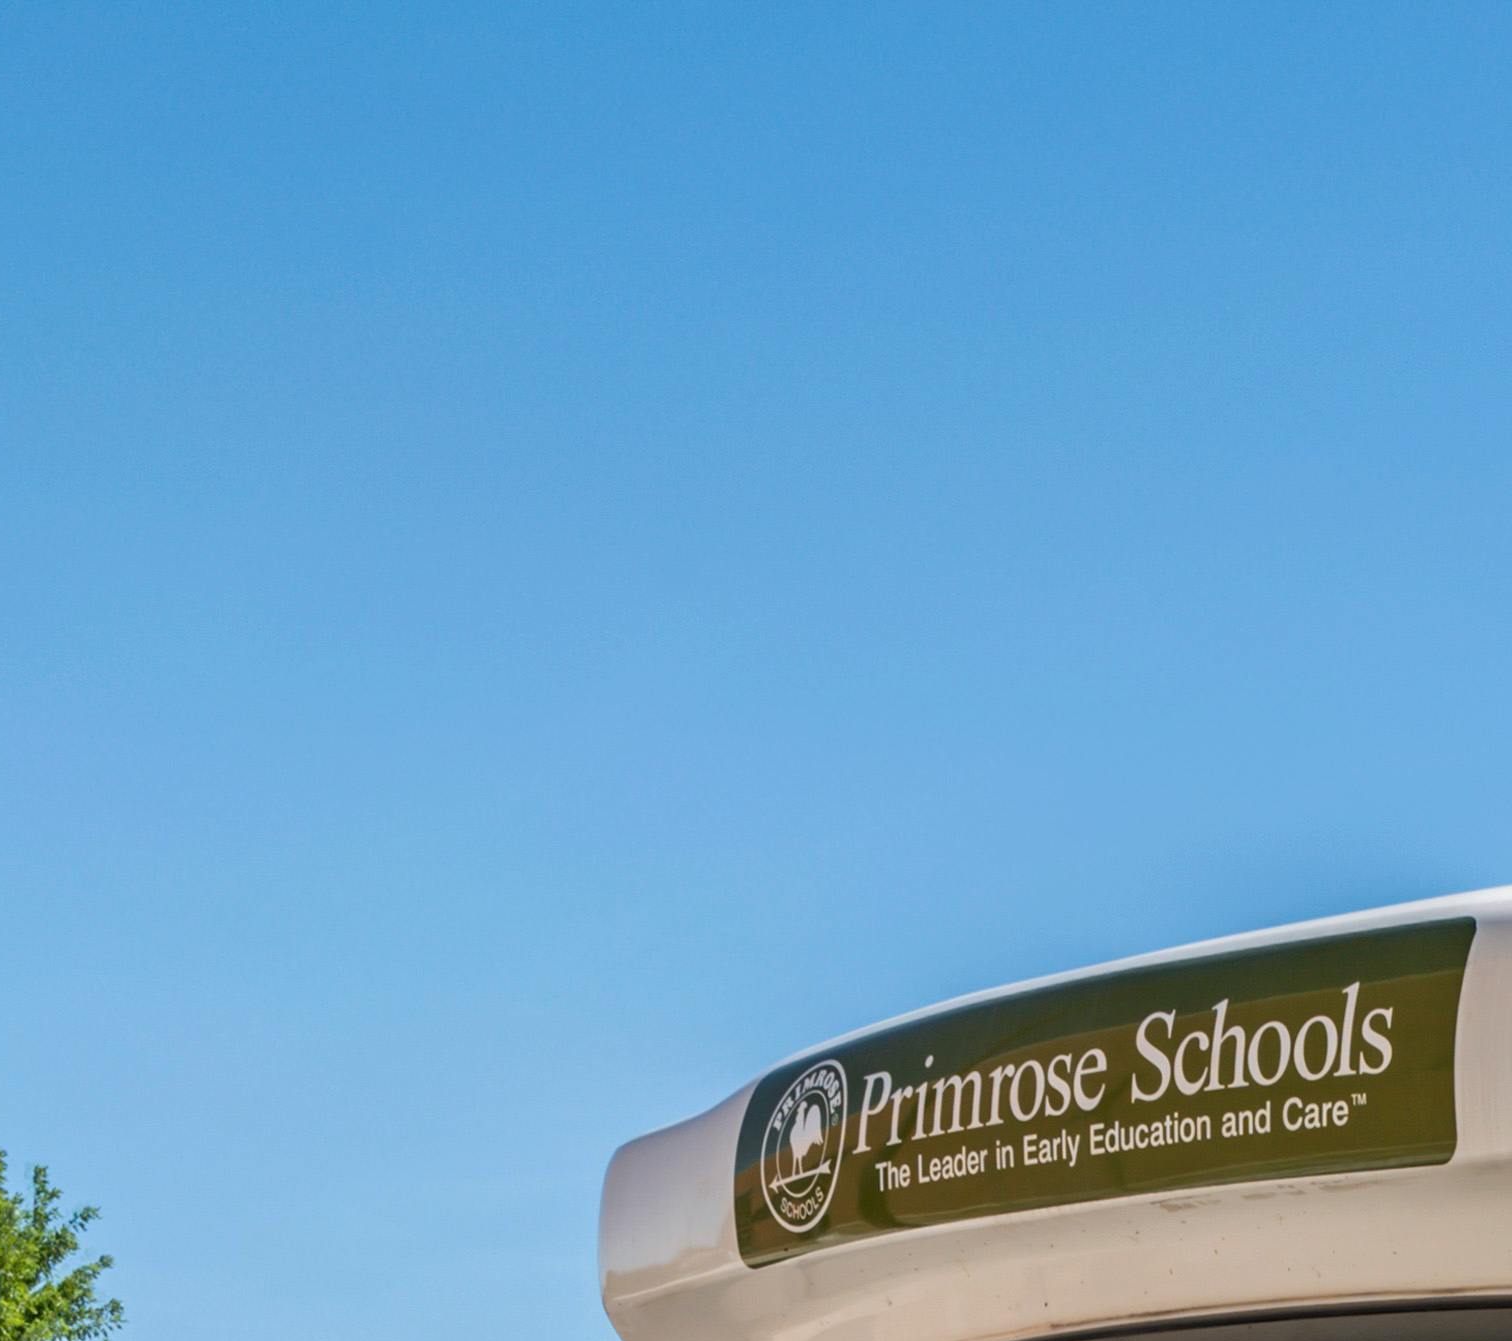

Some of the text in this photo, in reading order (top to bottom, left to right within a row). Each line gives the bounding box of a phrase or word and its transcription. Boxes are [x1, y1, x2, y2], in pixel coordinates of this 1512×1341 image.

[852, 981, 1393, 1155] Primrose Schools
[875, 1161, 911, 1192] The
[917, 1146, 988, 1184] Leader
[995, 1139, 1015, 1170] in
[1022, 1129, 1081, 1167] Early
[1089, 1111, 1211, 1156] Education
[1221, 1100, 1271, 1138] and
[780, 1186, 825, 1221] SCHOOLS
